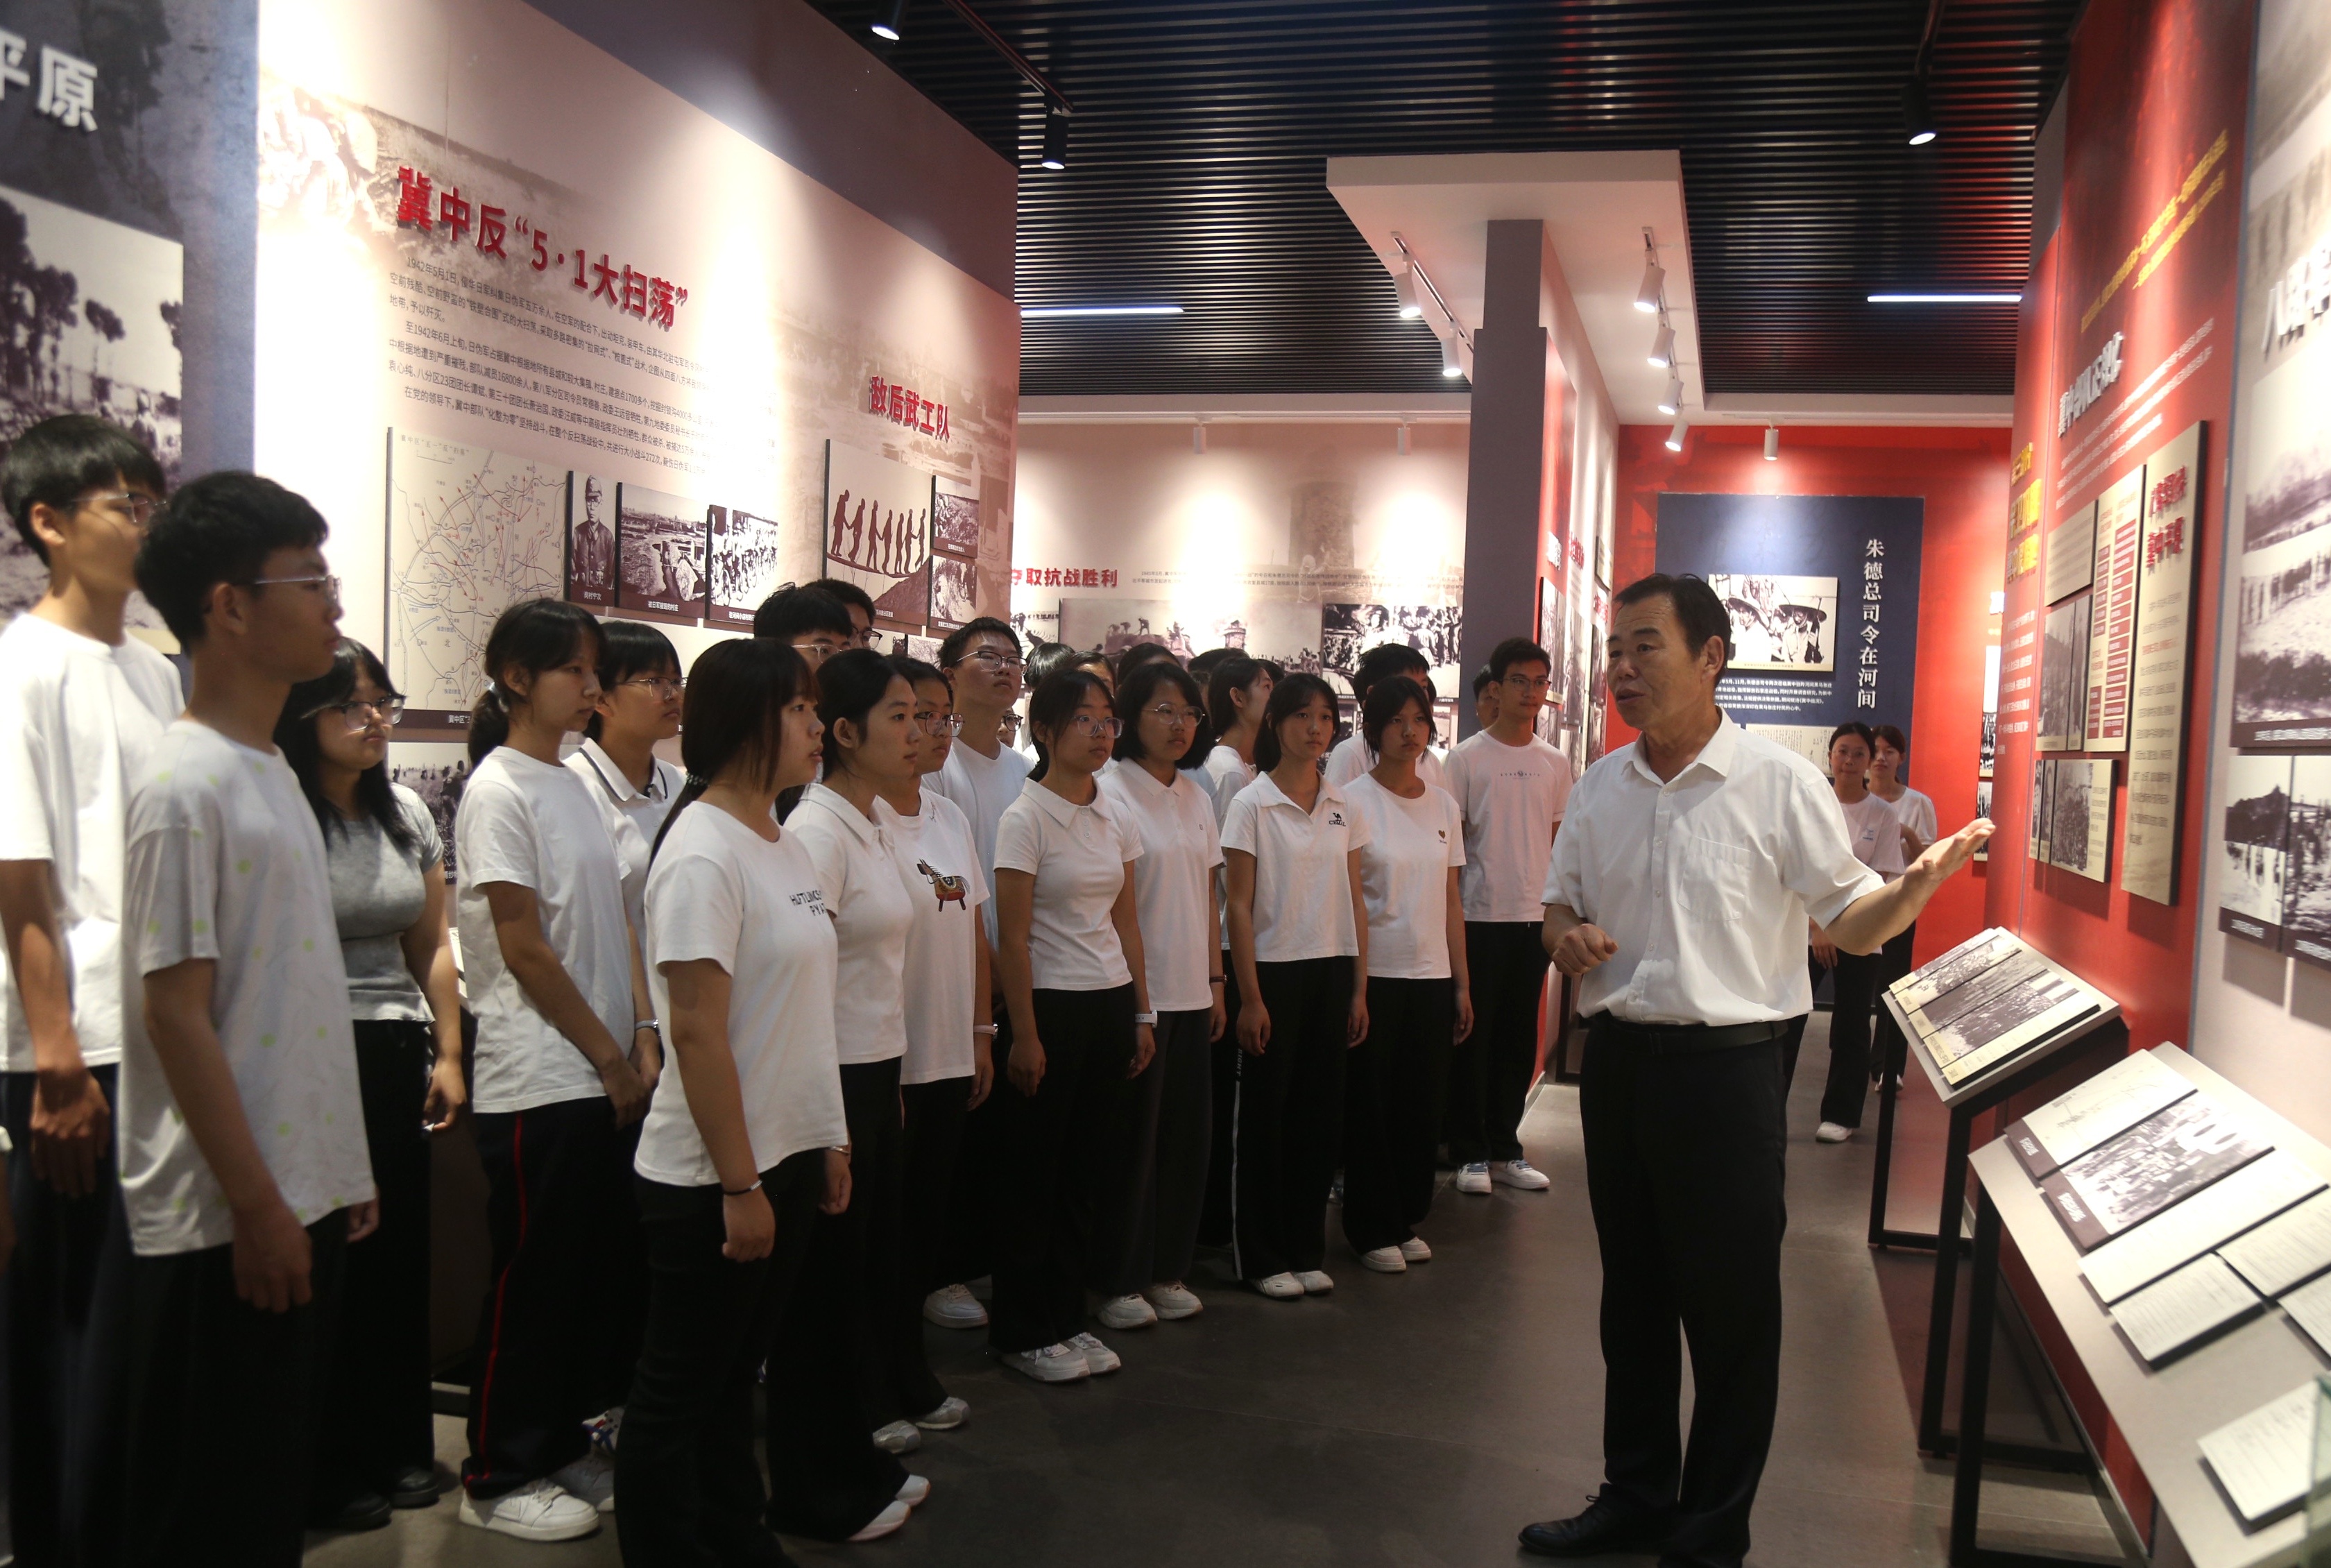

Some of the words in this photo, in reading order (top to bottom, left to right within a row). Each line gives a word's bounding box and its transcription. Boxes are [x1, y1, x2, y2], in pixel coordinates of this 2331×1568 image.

[871, 375, 950, 441] 敌后武工队
[1857, 538, 1885, 709] 朱德总司令在河间
